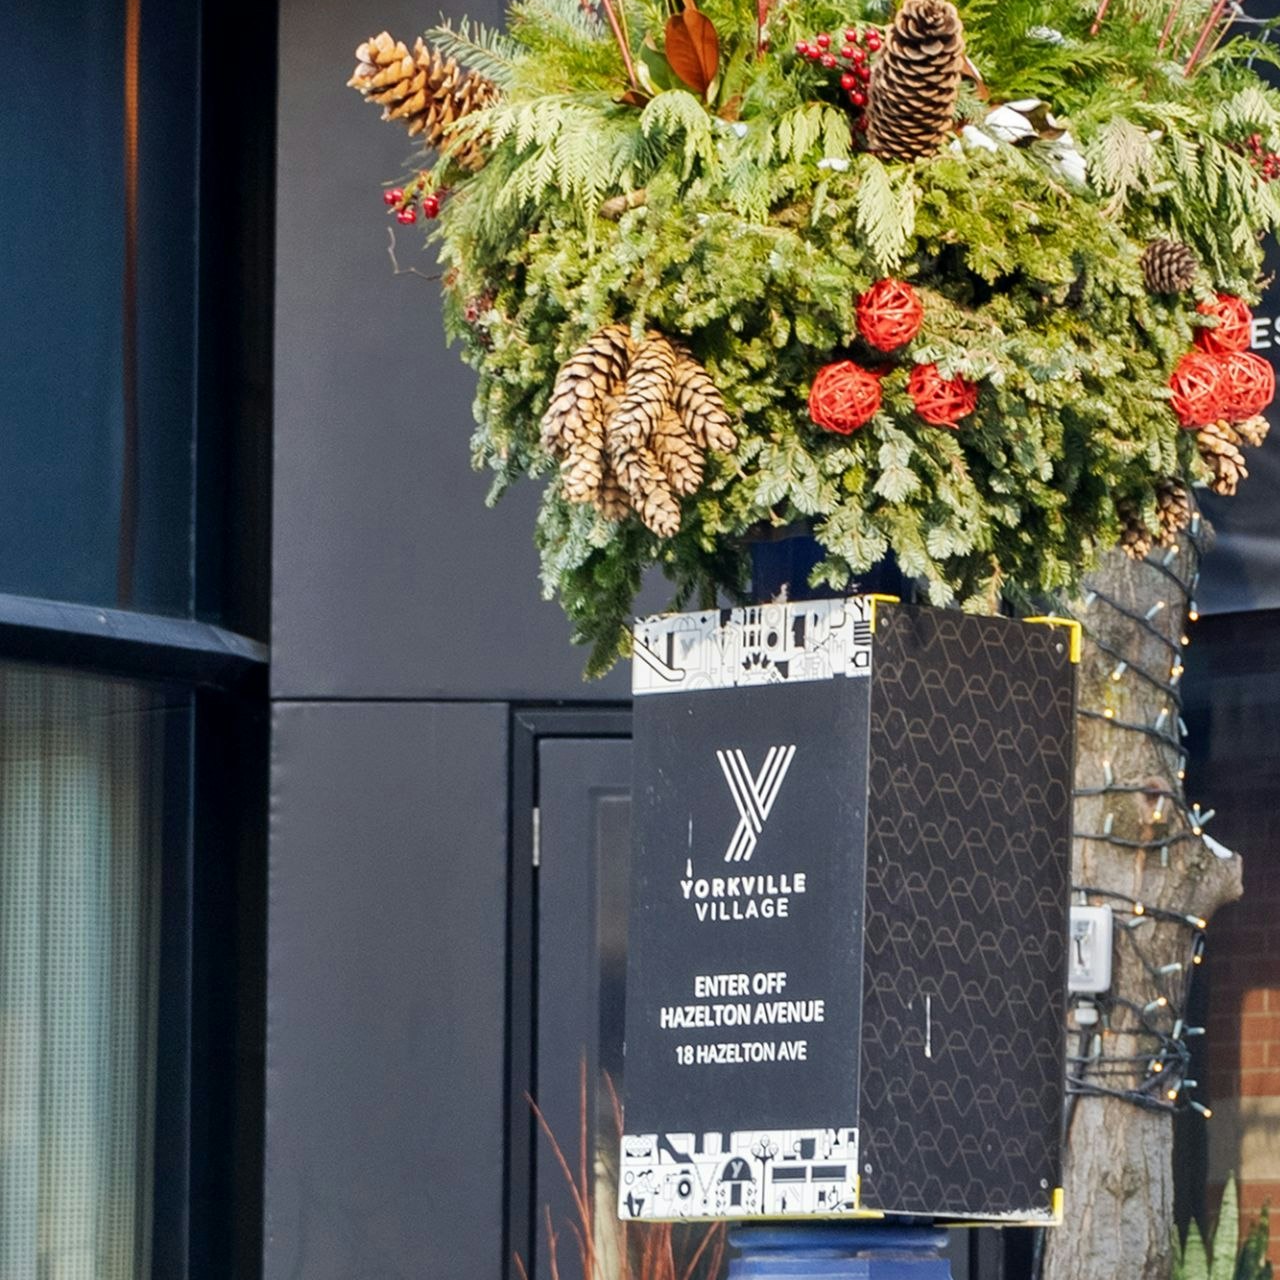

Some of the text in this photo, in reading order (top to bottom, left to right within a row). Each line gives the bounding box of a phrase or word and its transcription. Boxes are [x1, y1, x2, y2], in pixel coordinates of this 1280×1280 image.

[680, 872, 806, 900] YORKVILLE
[695, 897, 789, 922] VILLAGE
[695, 972, 787, 998] ENTER OFF
[660, 999, 825, 1029] HAZELTON AVENUE
[675, 1040, 808, 1065] 18 HAZELTON AVE
